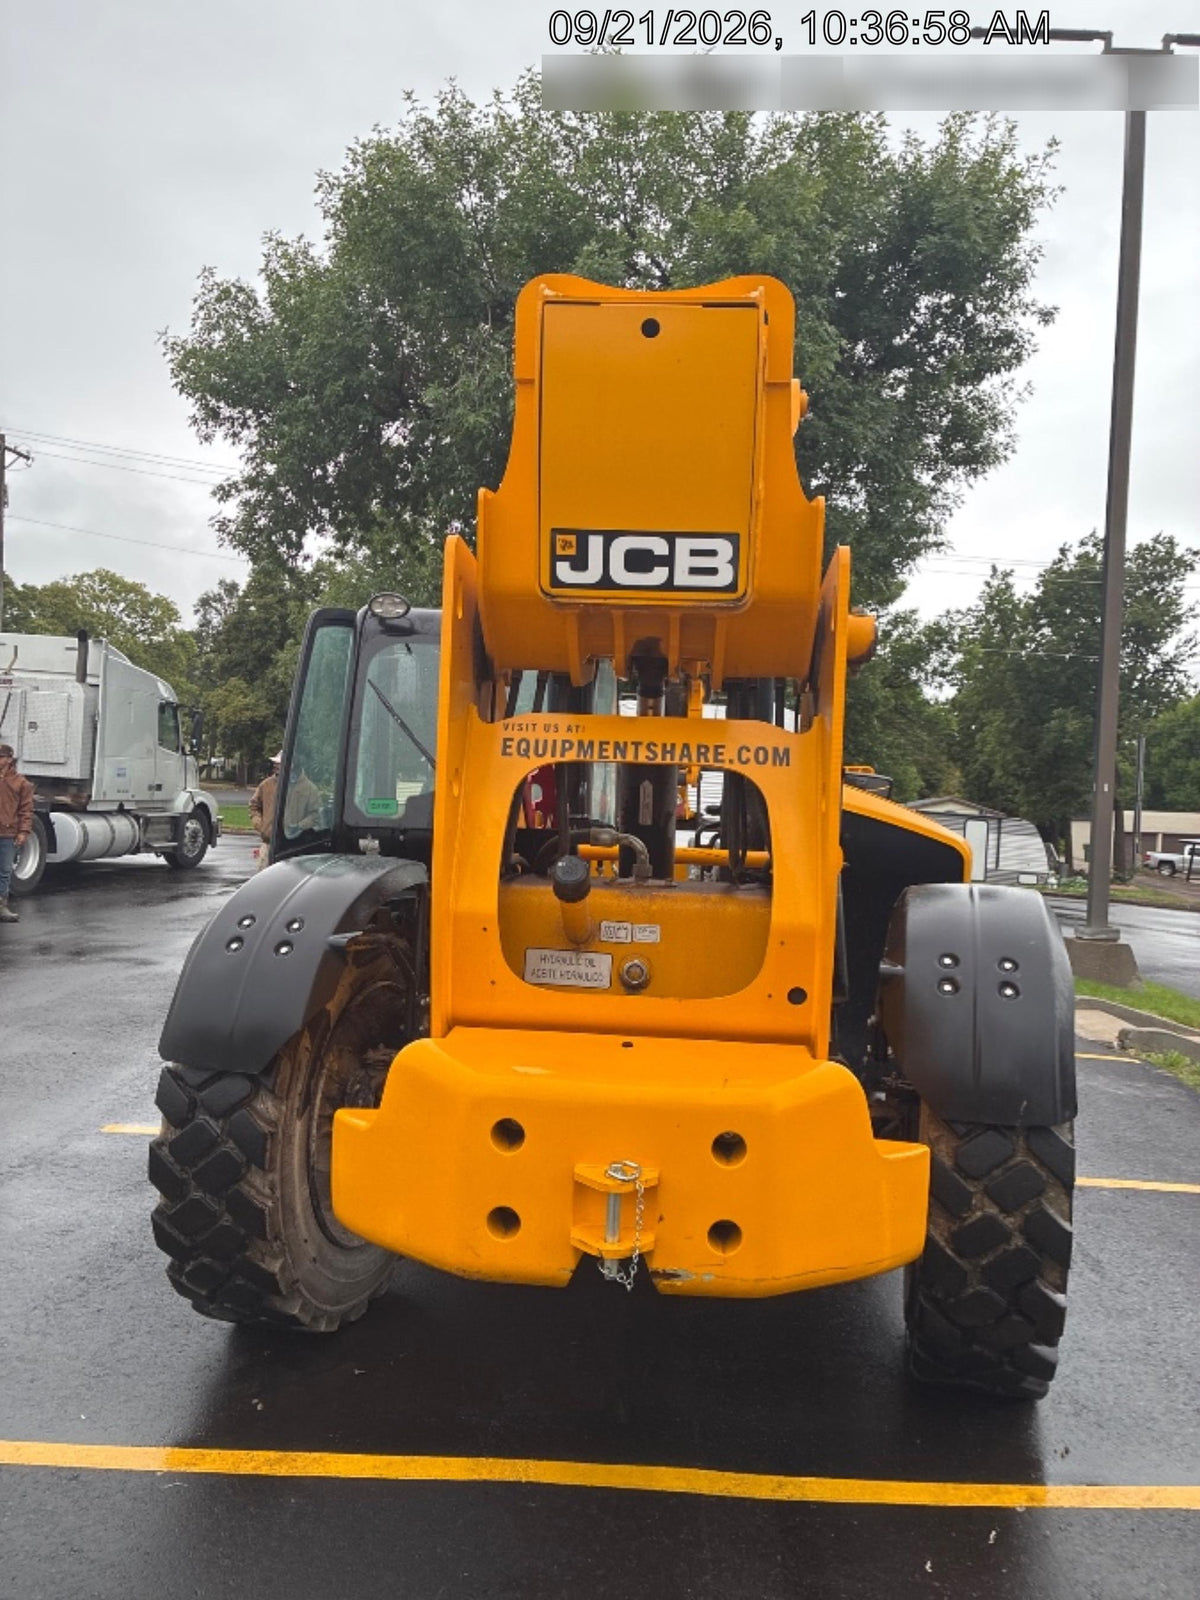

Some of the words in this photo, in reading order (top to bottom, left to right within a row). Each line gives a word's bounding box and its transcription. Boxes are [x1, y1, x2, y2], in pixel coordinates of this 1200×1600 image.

[556, 535, 734, 587] JCB
[502, 722, 537, 733] VISIT
[543, 723, 560, 733] US
[501, 737, 791, 767] EQUIPMENTSHARE.COM
